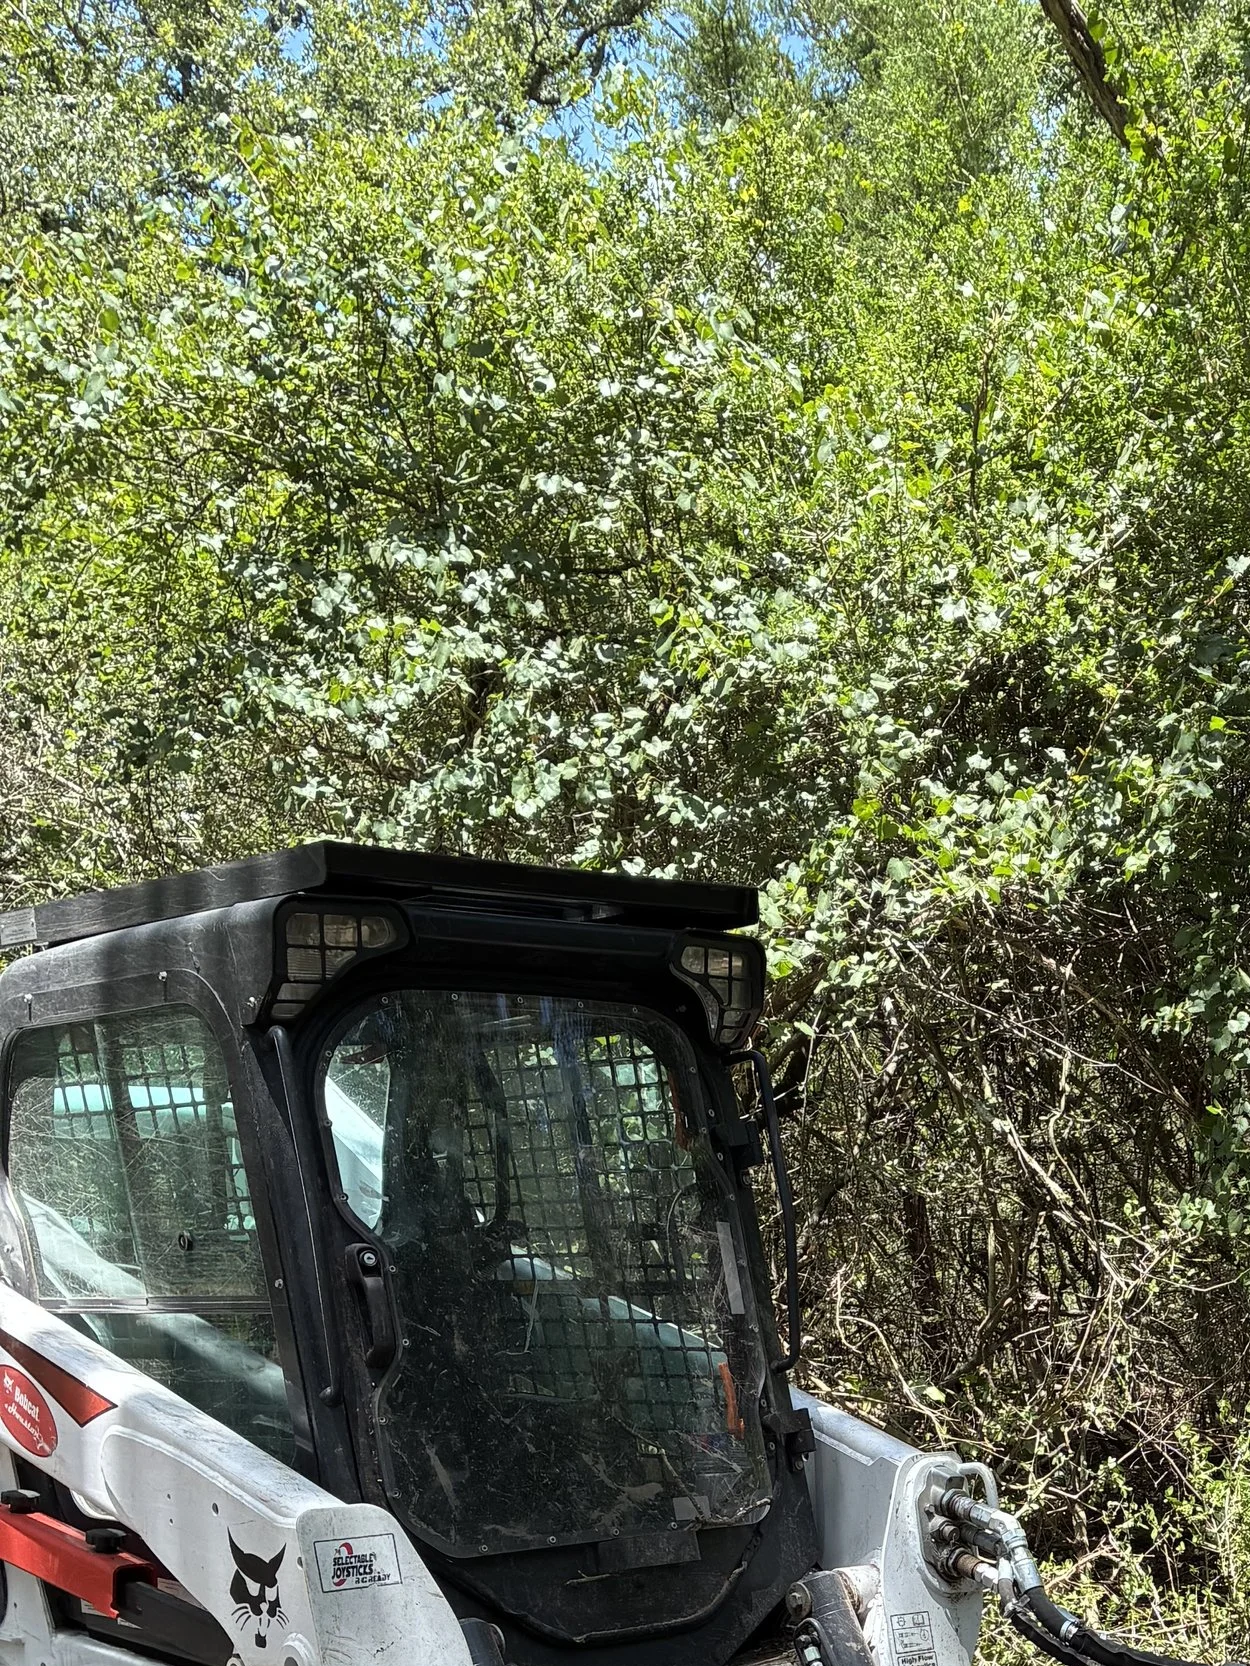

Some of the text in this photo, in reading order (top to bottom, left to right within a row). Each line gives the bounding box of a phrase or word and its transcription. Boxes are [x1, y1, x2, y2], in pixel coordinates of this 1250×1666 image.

[14, 1386, 40, 1422] Bobcat
[333, 1553, 373, 1567] SELECTABLE
[332, 1564, 373, 1580] JOYSTICKS
[901, 1655, 934, 1665] High Flow
